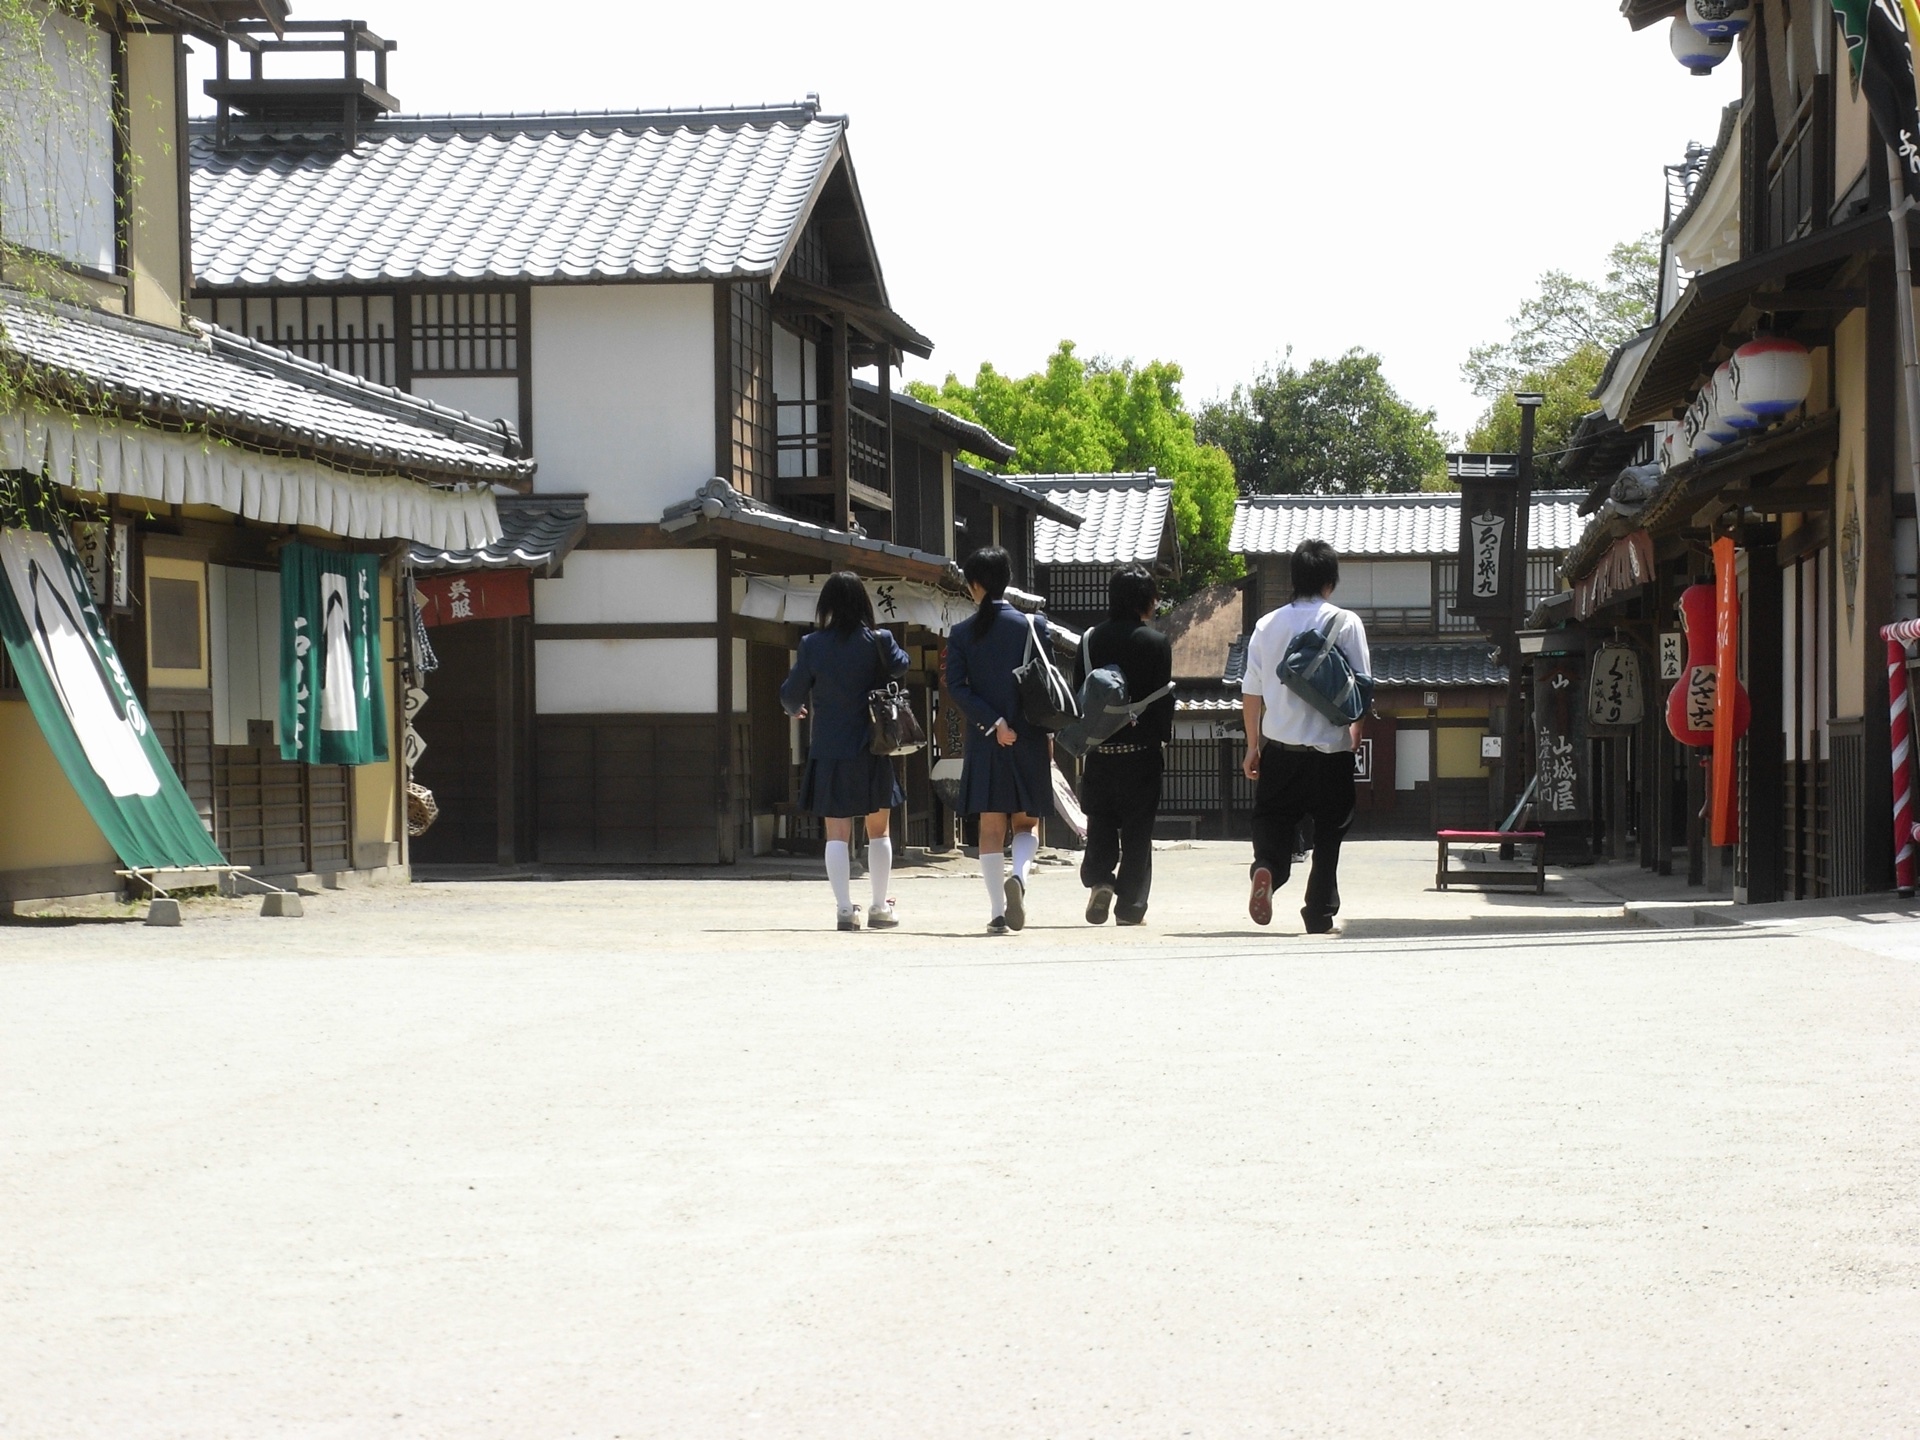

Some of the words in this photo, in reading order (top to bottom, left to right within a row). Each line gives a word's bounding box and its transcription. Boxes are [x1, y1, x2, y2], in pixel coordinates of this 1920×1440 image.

[447, 578, 474, 618] 呉服
[876, 585, 897, 618] 筆
[1663, 637, 1679, 677] 山城屋
[1552, 674, 1570, 689] 山
[1689, 668, 1716, 728] ひさご
[1552, 735, 1577, 812] 山城屋
